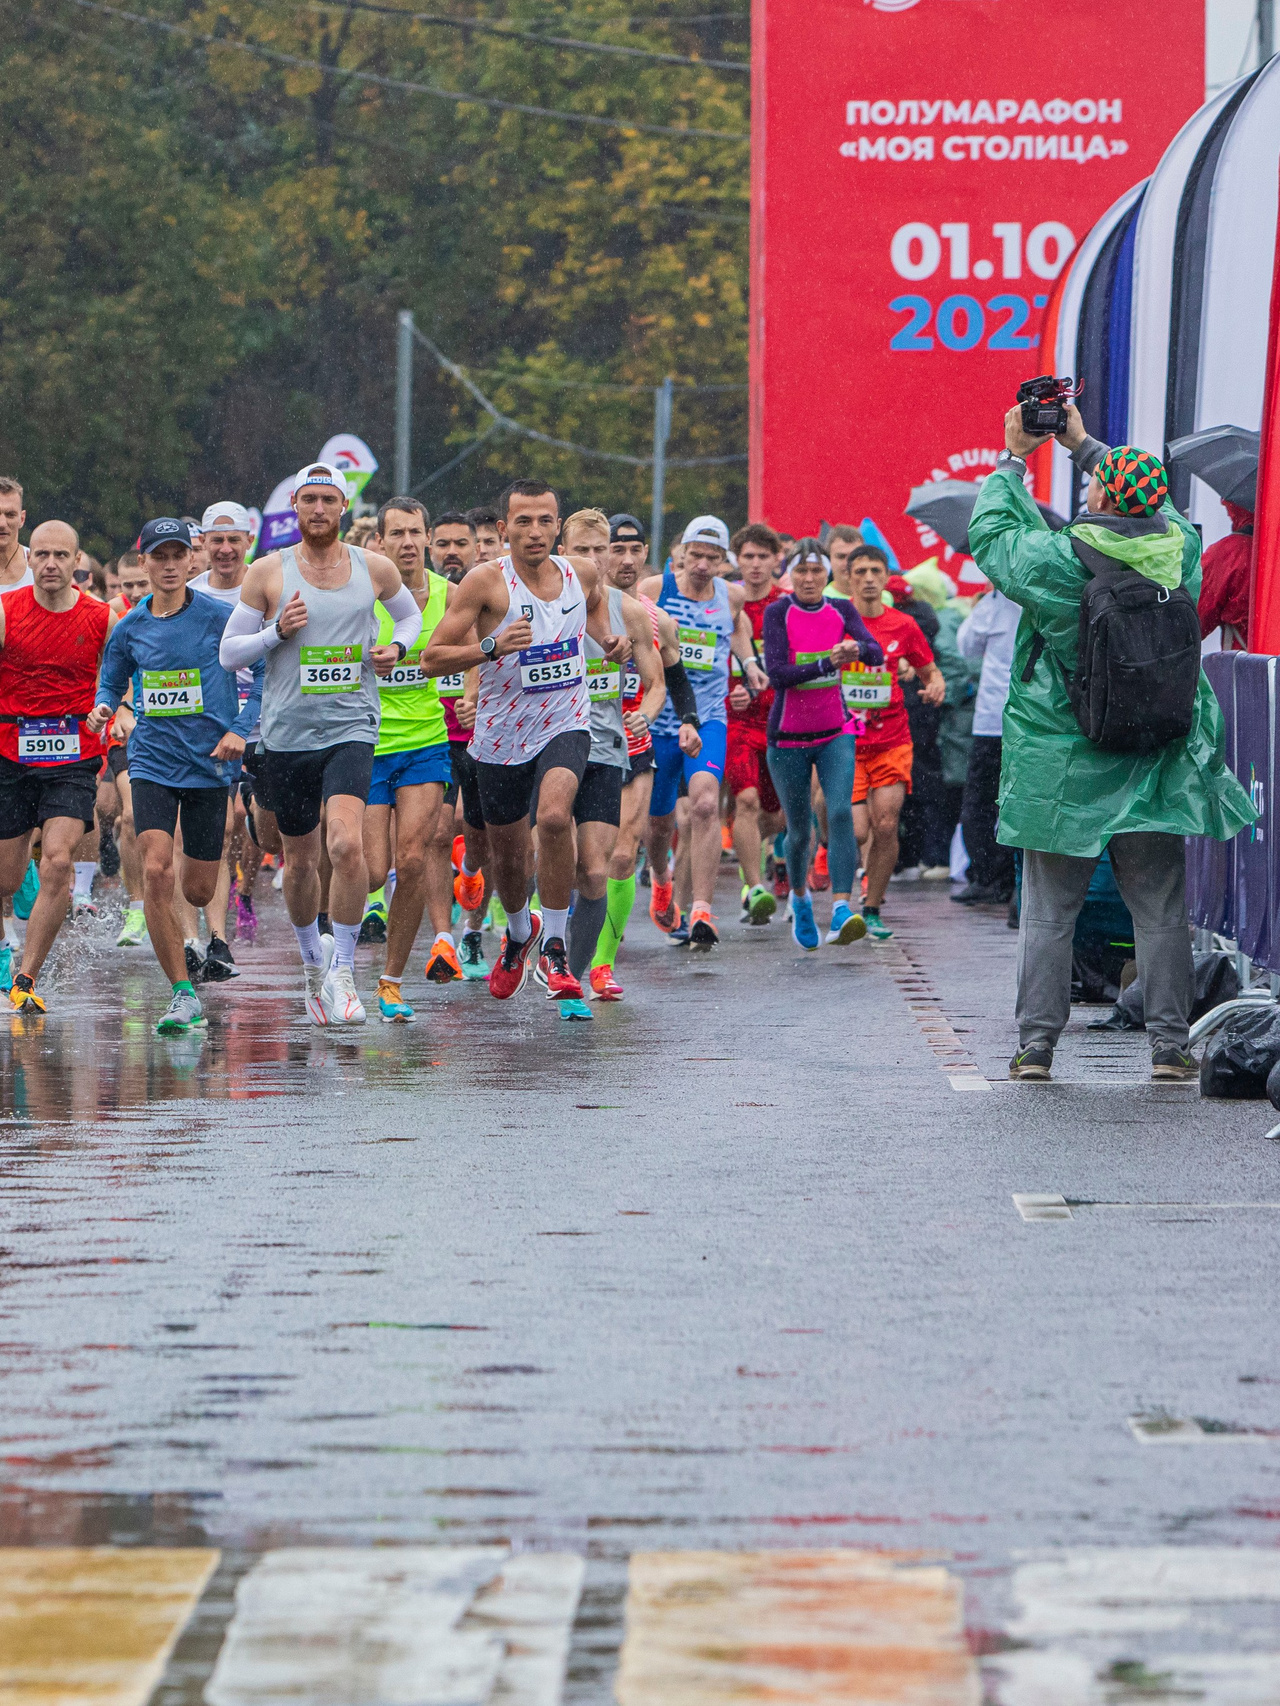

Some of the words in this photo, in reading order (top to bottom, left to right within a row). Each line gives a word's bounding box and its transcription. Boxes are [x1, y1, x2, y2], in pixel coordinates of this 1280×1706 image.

[846, 98, 1123, 126] ПОЛУМАРАФОН
[839, 135, 934, 162] «МОЯ
[942, 134, 1128, 164] СТОЛИЦА»
[890, 221, 1077, 281] 01.10
[307, 667, 352, 683] 3662
[528, 662, 572, 683] 6533
[588, 677, 609, 690] 43
[147, 691, 190, 706] 4074
[848, 688, 878, 699] 4161
[25, 738, 66, 753] 5910
